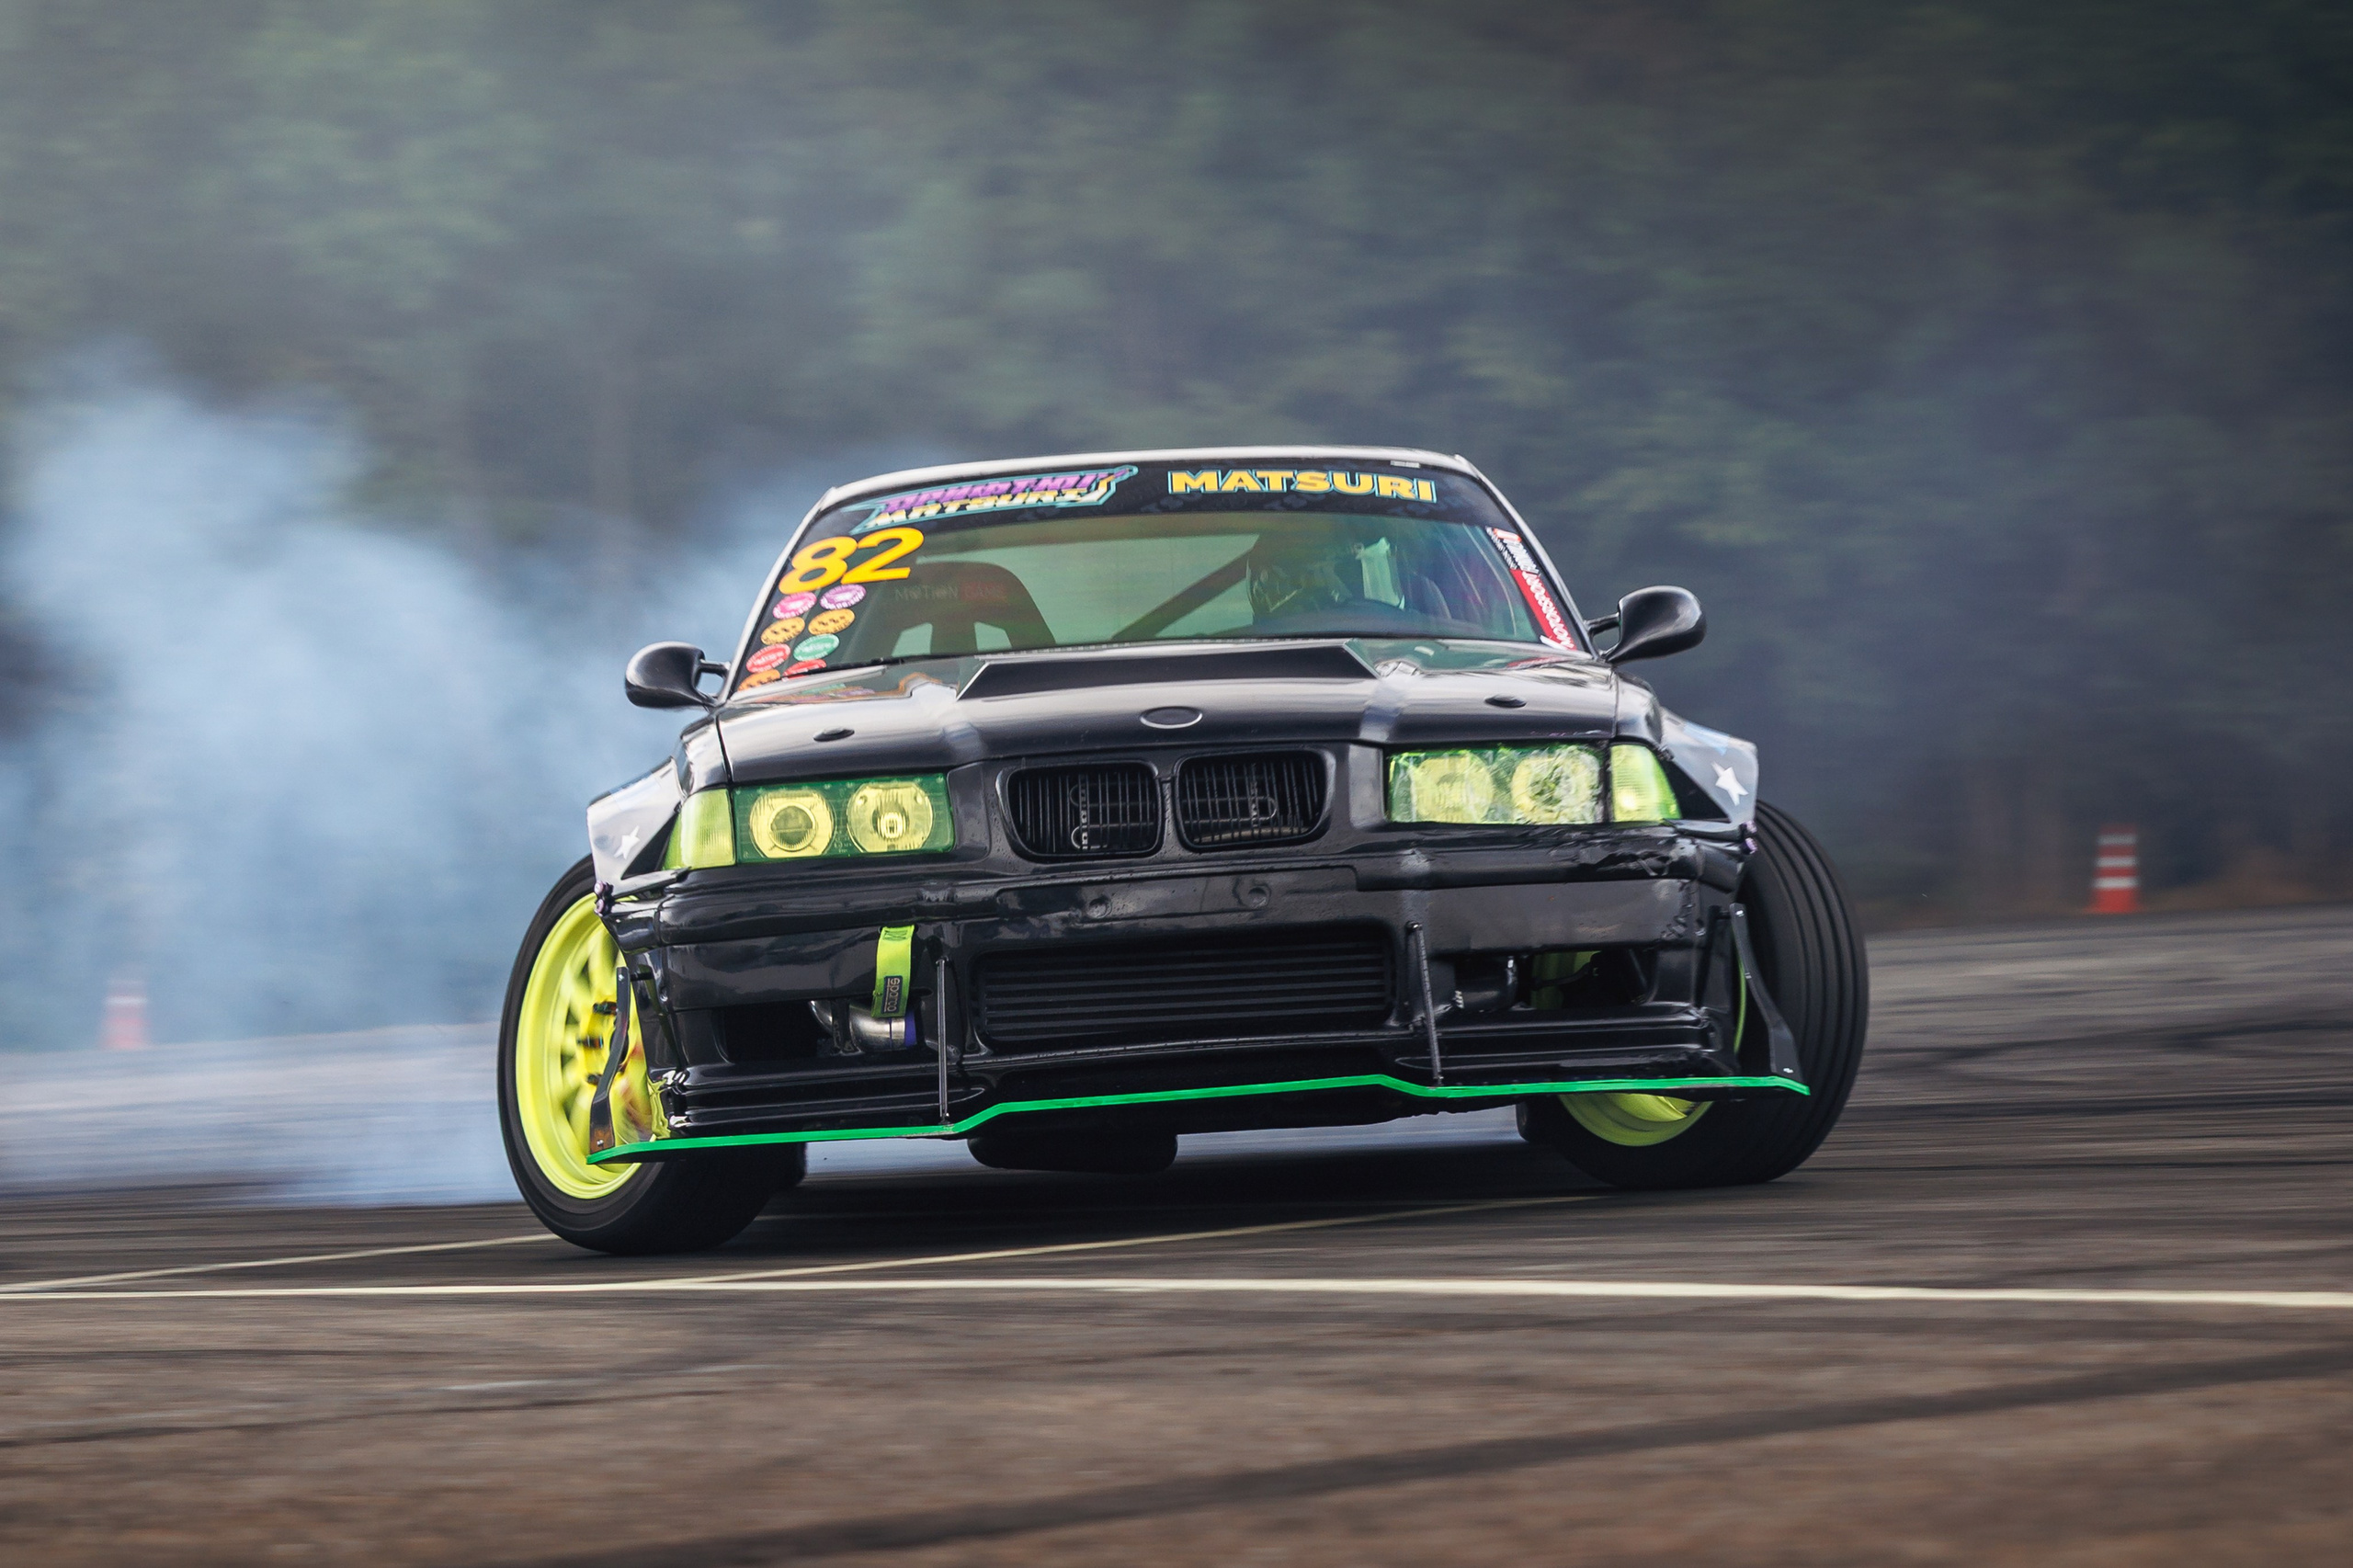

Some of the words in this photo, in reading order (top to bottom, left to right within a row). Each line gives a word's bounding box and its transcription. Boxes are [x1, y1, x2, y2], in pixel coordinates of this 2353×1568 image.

[1168, 470, 1436, 503] MATSURI
[779, 527, 924, 595] 82
[1522, 571, 1574, 649] MOTORSPORT
[885, 977, 901, 1012] sparco
